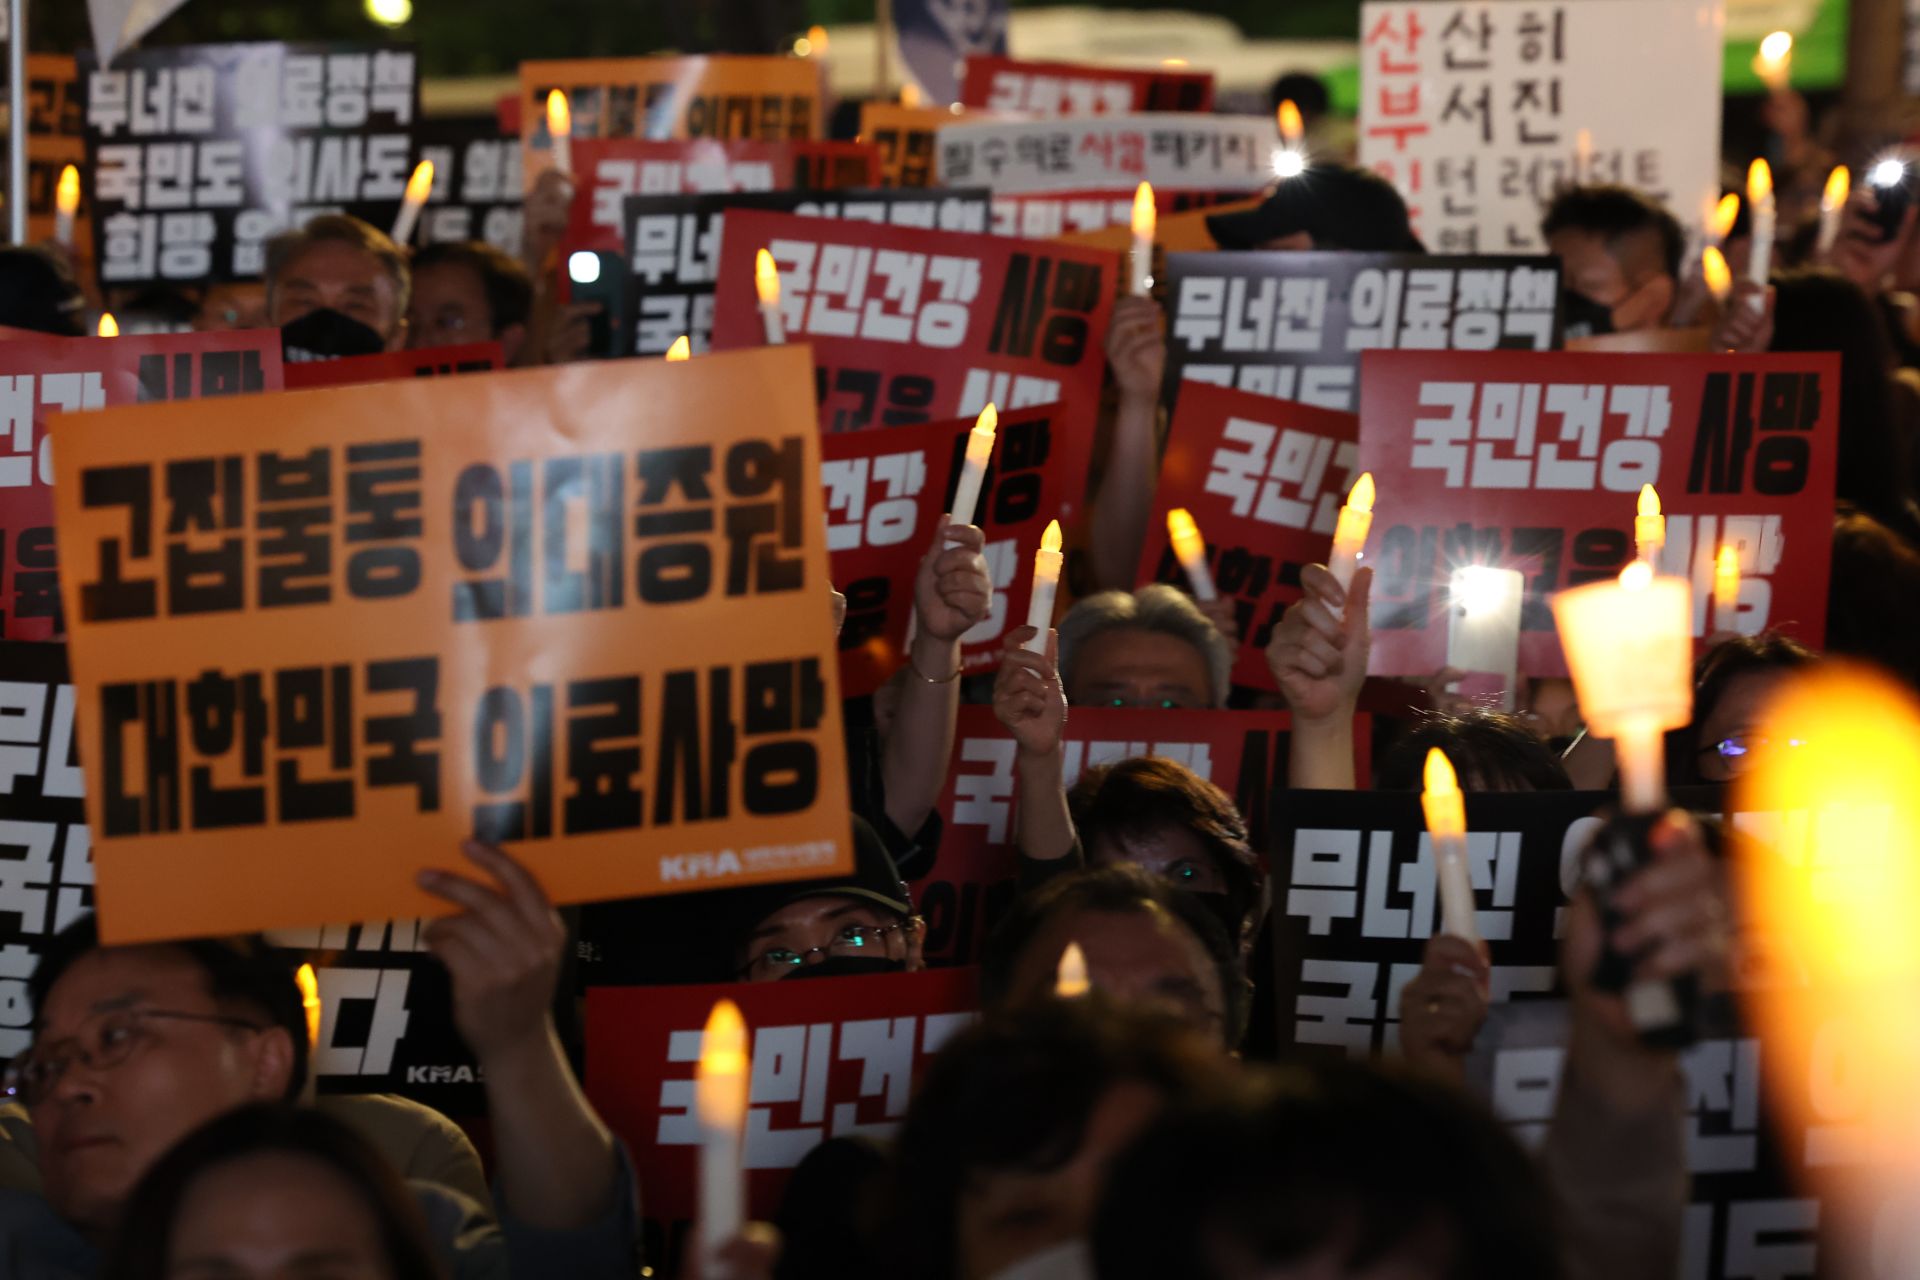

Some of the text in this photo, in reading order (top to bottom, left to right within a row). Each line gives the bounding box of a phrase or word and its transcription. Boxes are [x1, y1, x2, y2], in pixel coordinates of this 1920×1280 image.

[87, 66, 216, 136] 무너진
[94, 142, 244, 210] 국민도
[101, 211, 217, 281] 희망
[762, 238, 982, 350] 국민건강
[988, 253, 1104, 367] 사망
[1173, 266, 1559, 352] 무너진 의료정책
[1409, 381, 1673, 493] 국민건강
[1686, 370, 1823, 496] 사망
[79, 438, 424, 624] 고집불통
[452, 434, 807, 623] 의대증원
[101, 655, 444, 839] 대한민국
[472, 655, 827, 845] 의료사망
[406, 1064, 474, 1084] KMA
